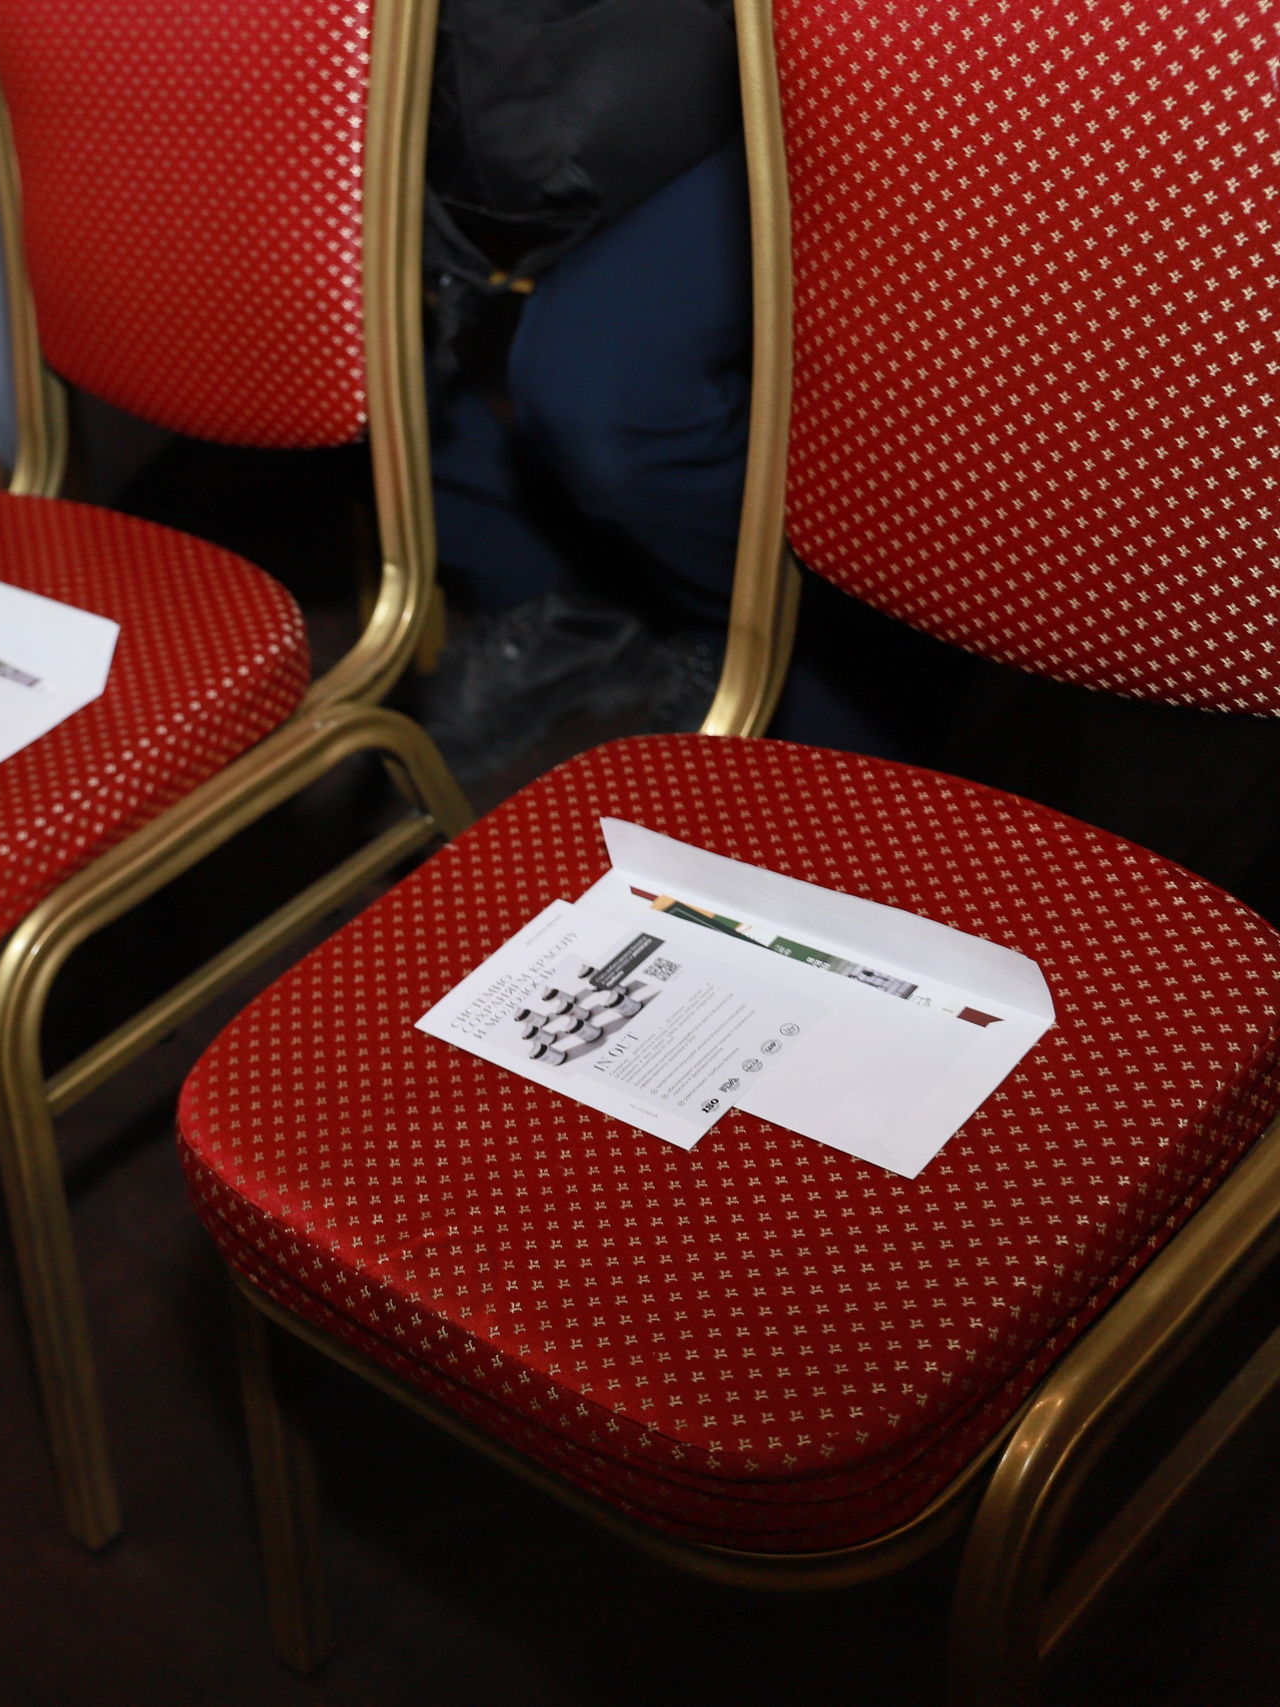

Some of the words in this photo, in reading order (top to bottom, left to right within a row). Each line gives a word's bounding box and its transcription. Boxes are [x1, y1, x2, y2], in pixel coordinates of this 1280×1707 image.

[450, 974, 513, 1029] СИСТЕМНО
[462, 973, 532, 1034] СОХРАНЯЕМ
[528, 931, 577, 974] КРАСОТУ
[484, 966, 556, 1028] МОЛОДОСТЬ
[701, 1098, 719, 1114] ISO
